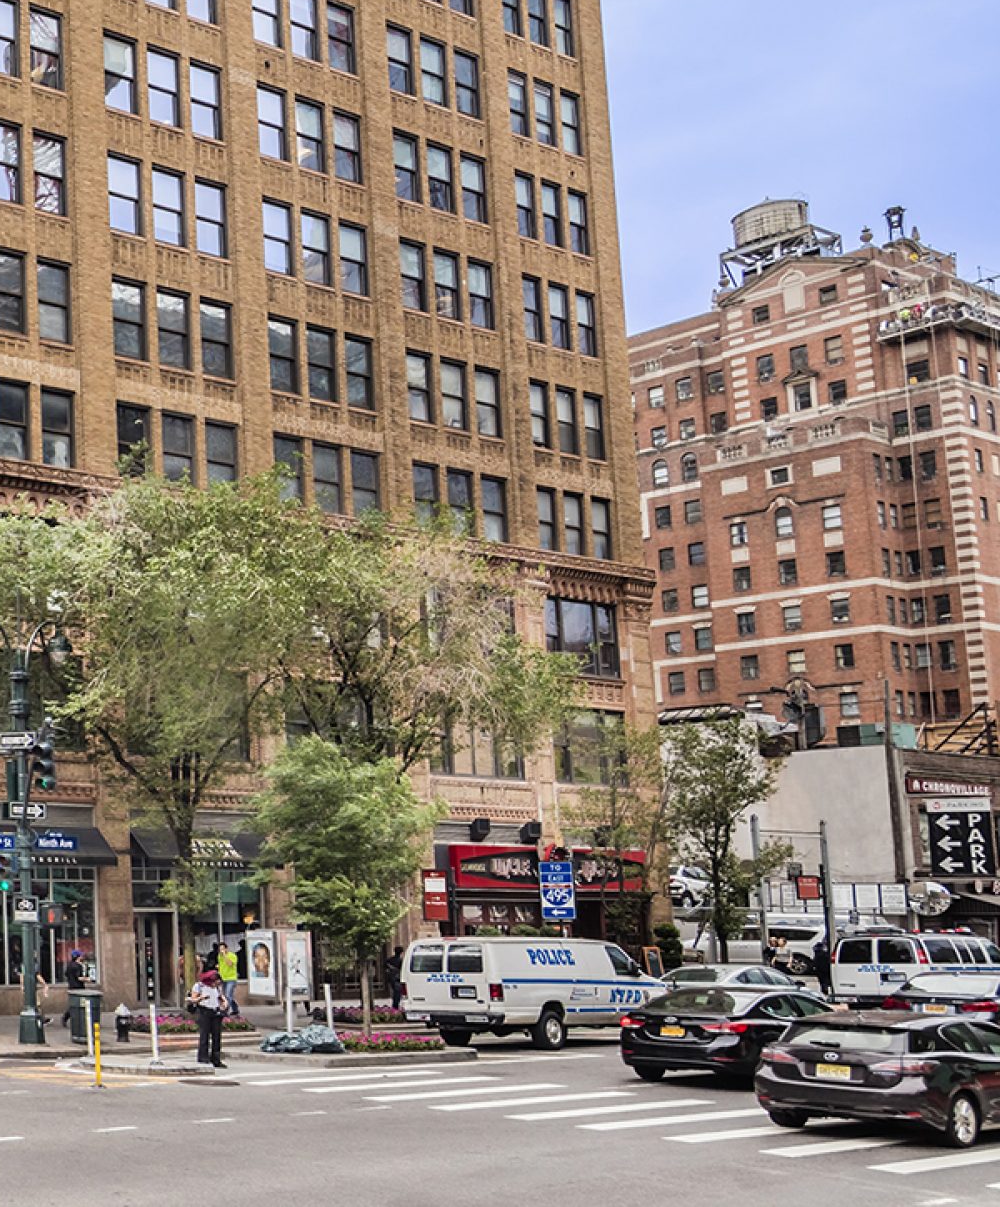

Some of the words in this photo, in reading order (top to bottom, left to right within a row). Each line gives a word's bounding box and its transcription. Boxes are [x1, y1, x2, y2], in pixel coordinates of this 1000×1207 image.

[967, 813, 989, 874] PARK
[546, 889, 569, 903] 495
[526, 948, 576, 966] POLICE
[609, 987, 642, 1004] NYPD
